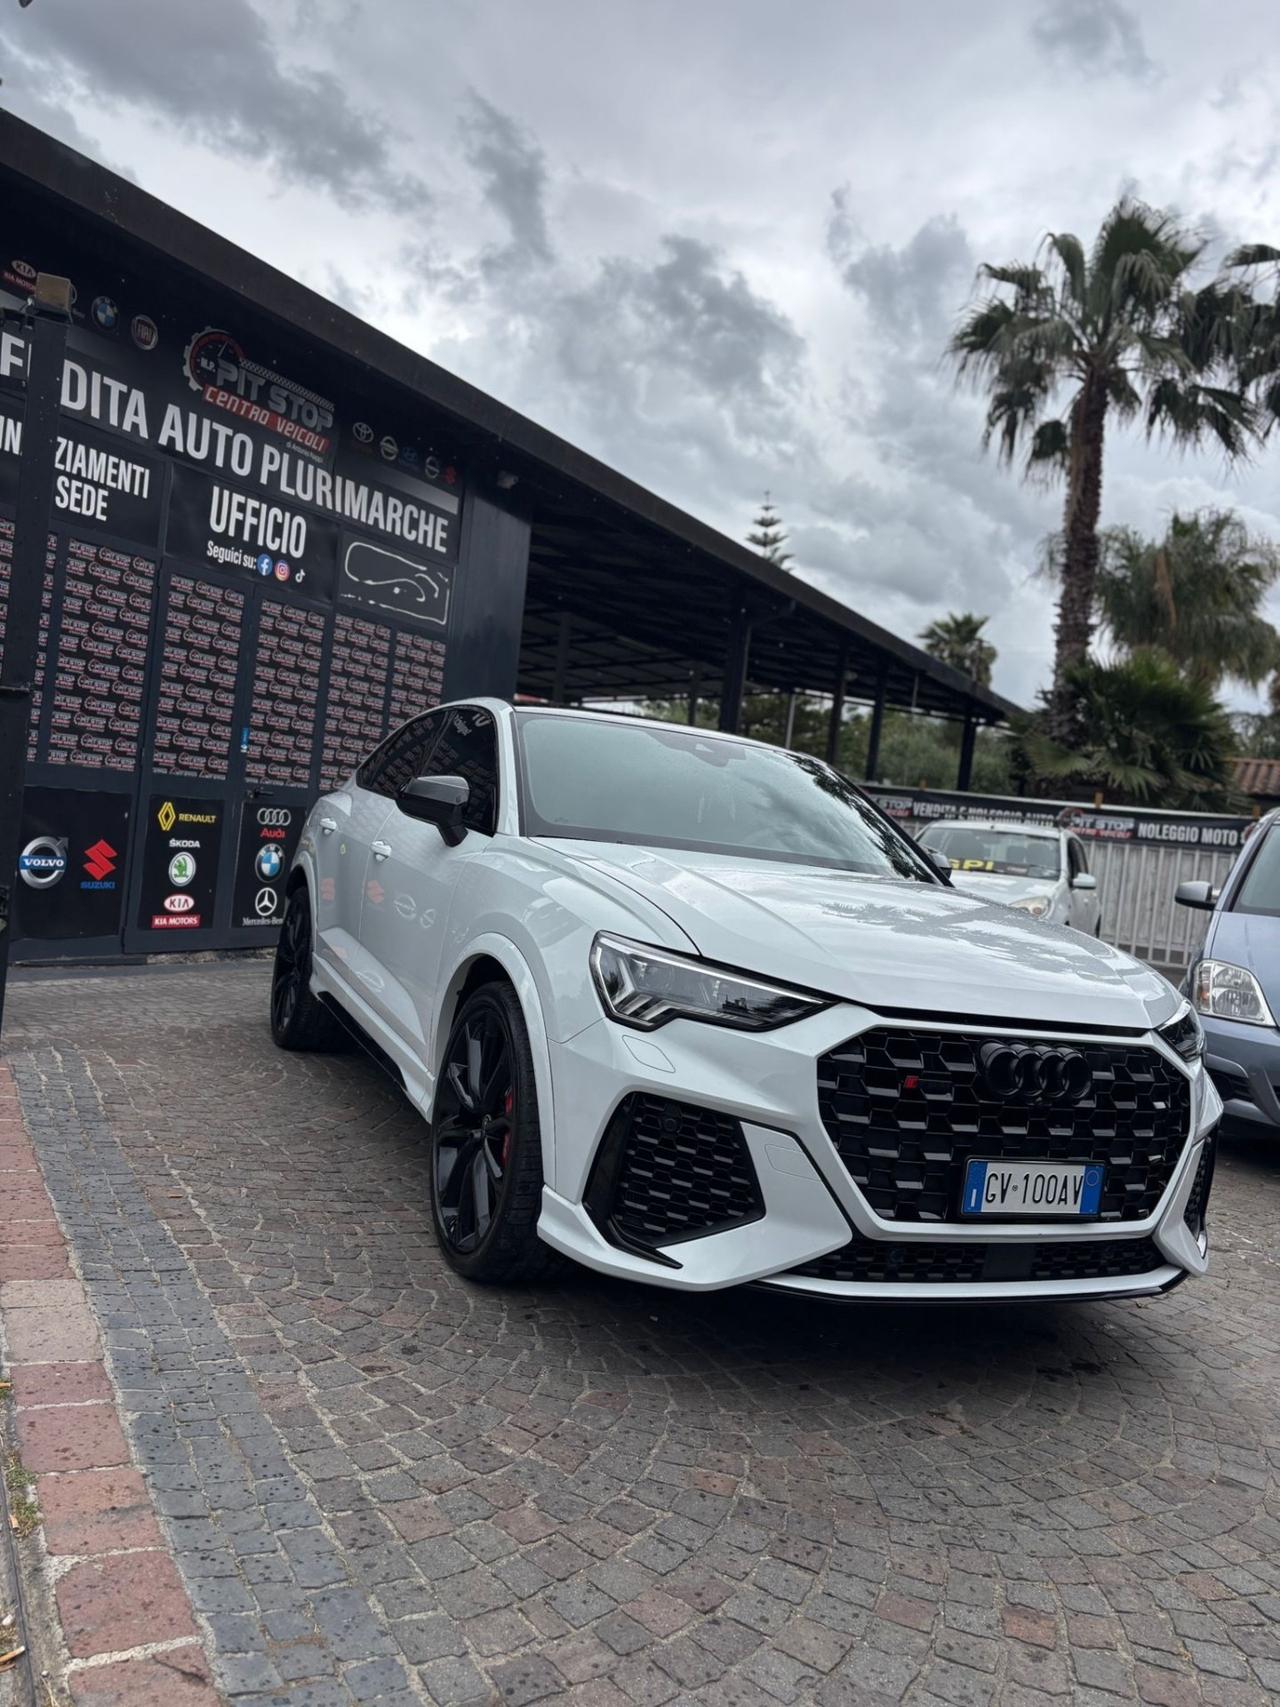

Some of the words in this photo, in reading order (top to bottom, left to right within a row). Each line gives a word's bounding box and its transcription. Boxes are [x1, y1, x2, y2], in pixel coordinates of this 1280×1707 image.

[217, 359, 266, 401] PIT
[267, 384, 334, 433] STOP
[158, 403, 254, 477] AUTO
[260, 443, 449, 553] PLURIMARCHE
[55, 475, 109, 522] SEDE
[209, 485, 307, 559] UFFICIO
[206, 540, 242, 566] Seguici
[242, 553, 257, 570] su:
[178, 813, 216, 824] RENAULT
[260, 827, 286, 839] Audi
[1137, 822, 1199, 843] NOLEGGIO
[1201, 828, 1239, 847] MOTO
[169, 838, 201, 848] ŠKODA
[24, 858, 65, 868] VOLVO
[80, 880, 116, 890] SUZUKI
[168, 898, 190, 909] KIA
[154, 917, 168, 927] KIA
[168, 916, 199, 926] MOTORS
[985, 1172, 1013, 1204] GV
[1022, 1173, 1084, 1206] 100AV
